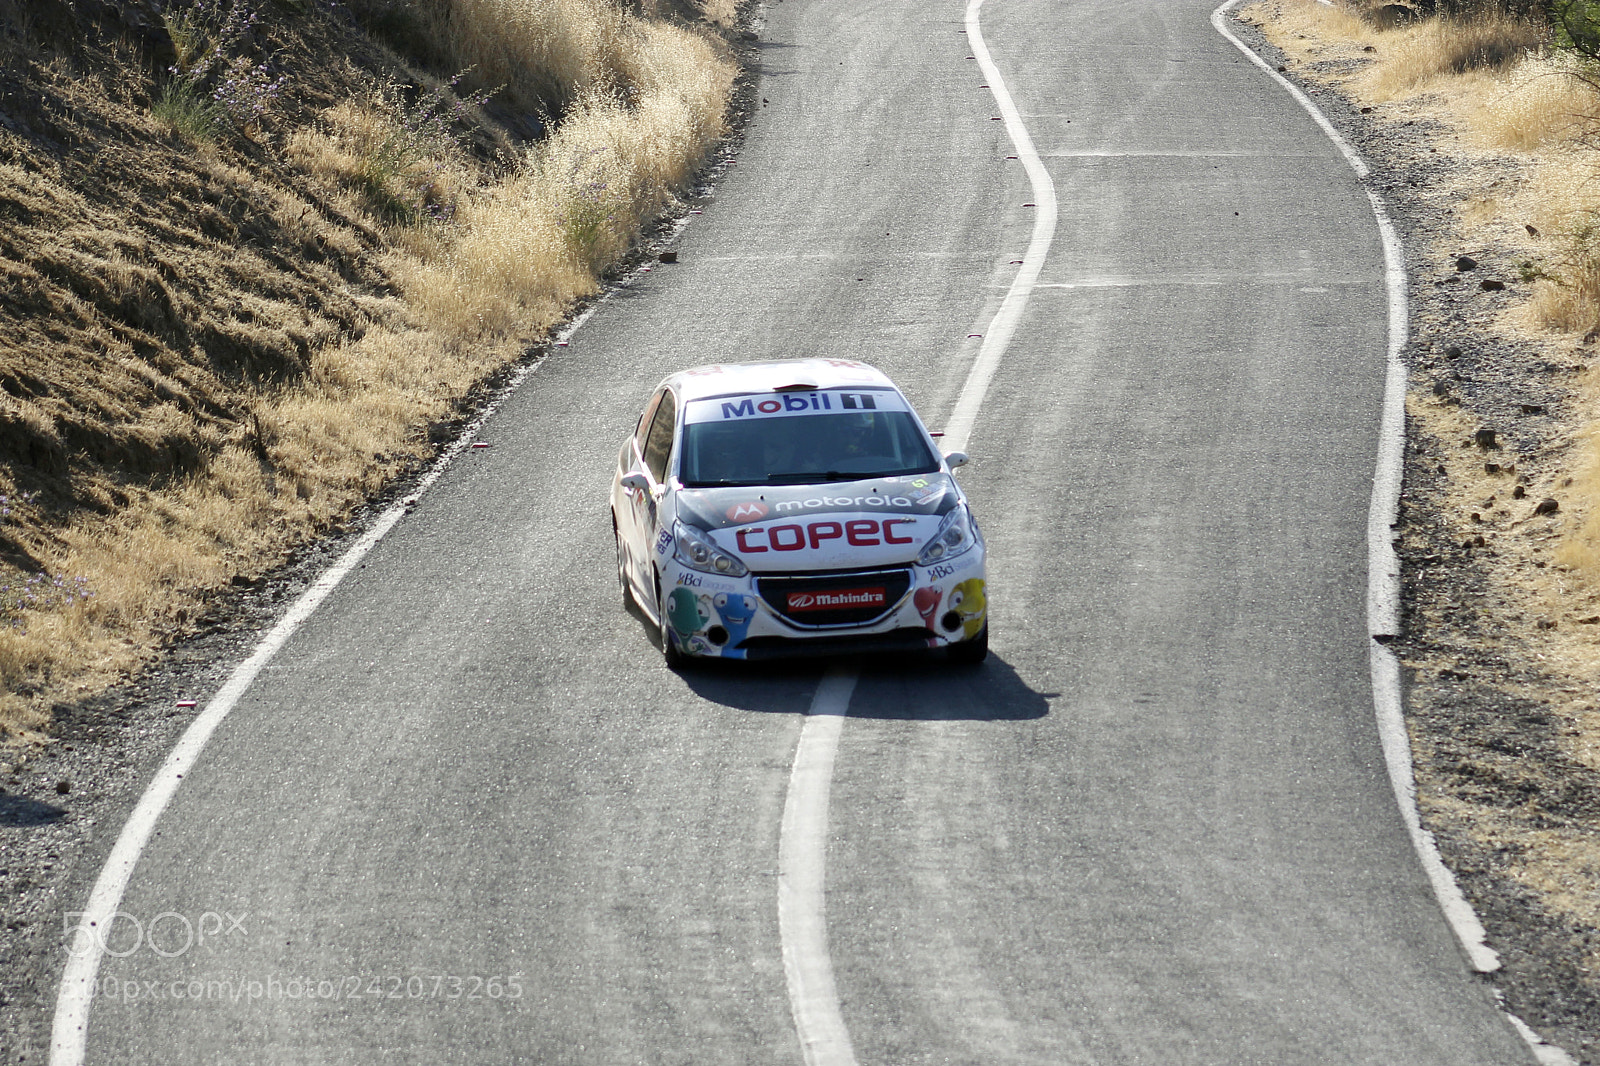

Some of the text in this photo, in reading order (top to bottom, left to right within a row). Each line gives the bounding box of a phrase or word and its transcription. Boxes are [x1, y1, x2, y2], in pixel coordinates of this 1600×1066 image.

[721, 393, 831, 419] Mobil
[775, 495, 912, 512] motorola
[684, 572, 703, 587] Bci
[816, 592, 884, 605] Mahindra
